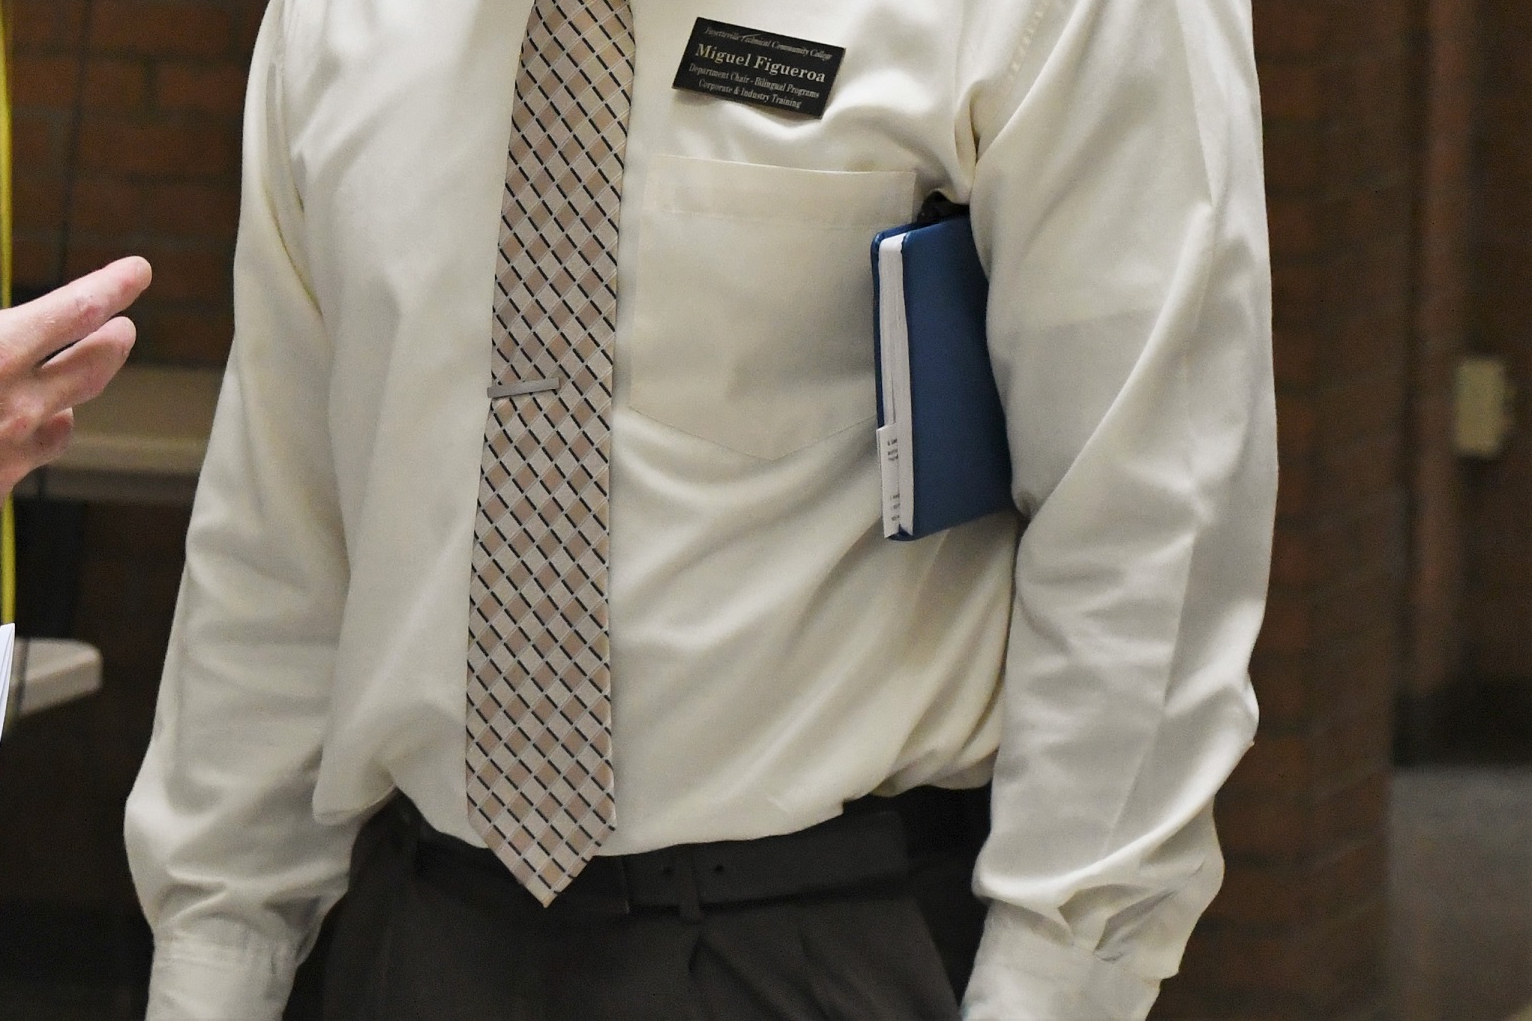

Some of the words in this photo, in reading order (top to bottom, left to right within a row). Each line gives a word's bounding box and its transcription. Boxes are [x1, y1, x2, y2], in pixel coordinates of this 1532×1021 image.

[695, 43, 751, 66] Miguel
[753, 55, 826, 82] Figueroa
[689, 63, 729, 79] Department
[730, 72, 750, 83] Chair
[754, 77, 787, 92] Bilingual
[786, 83, 820, 98] Programs
[698, 78, 733, 93] Corporate
[733, 86, 740, 95] &
[740, 87, 770, 103] Industry
[771, 93, 803, 109] Training
